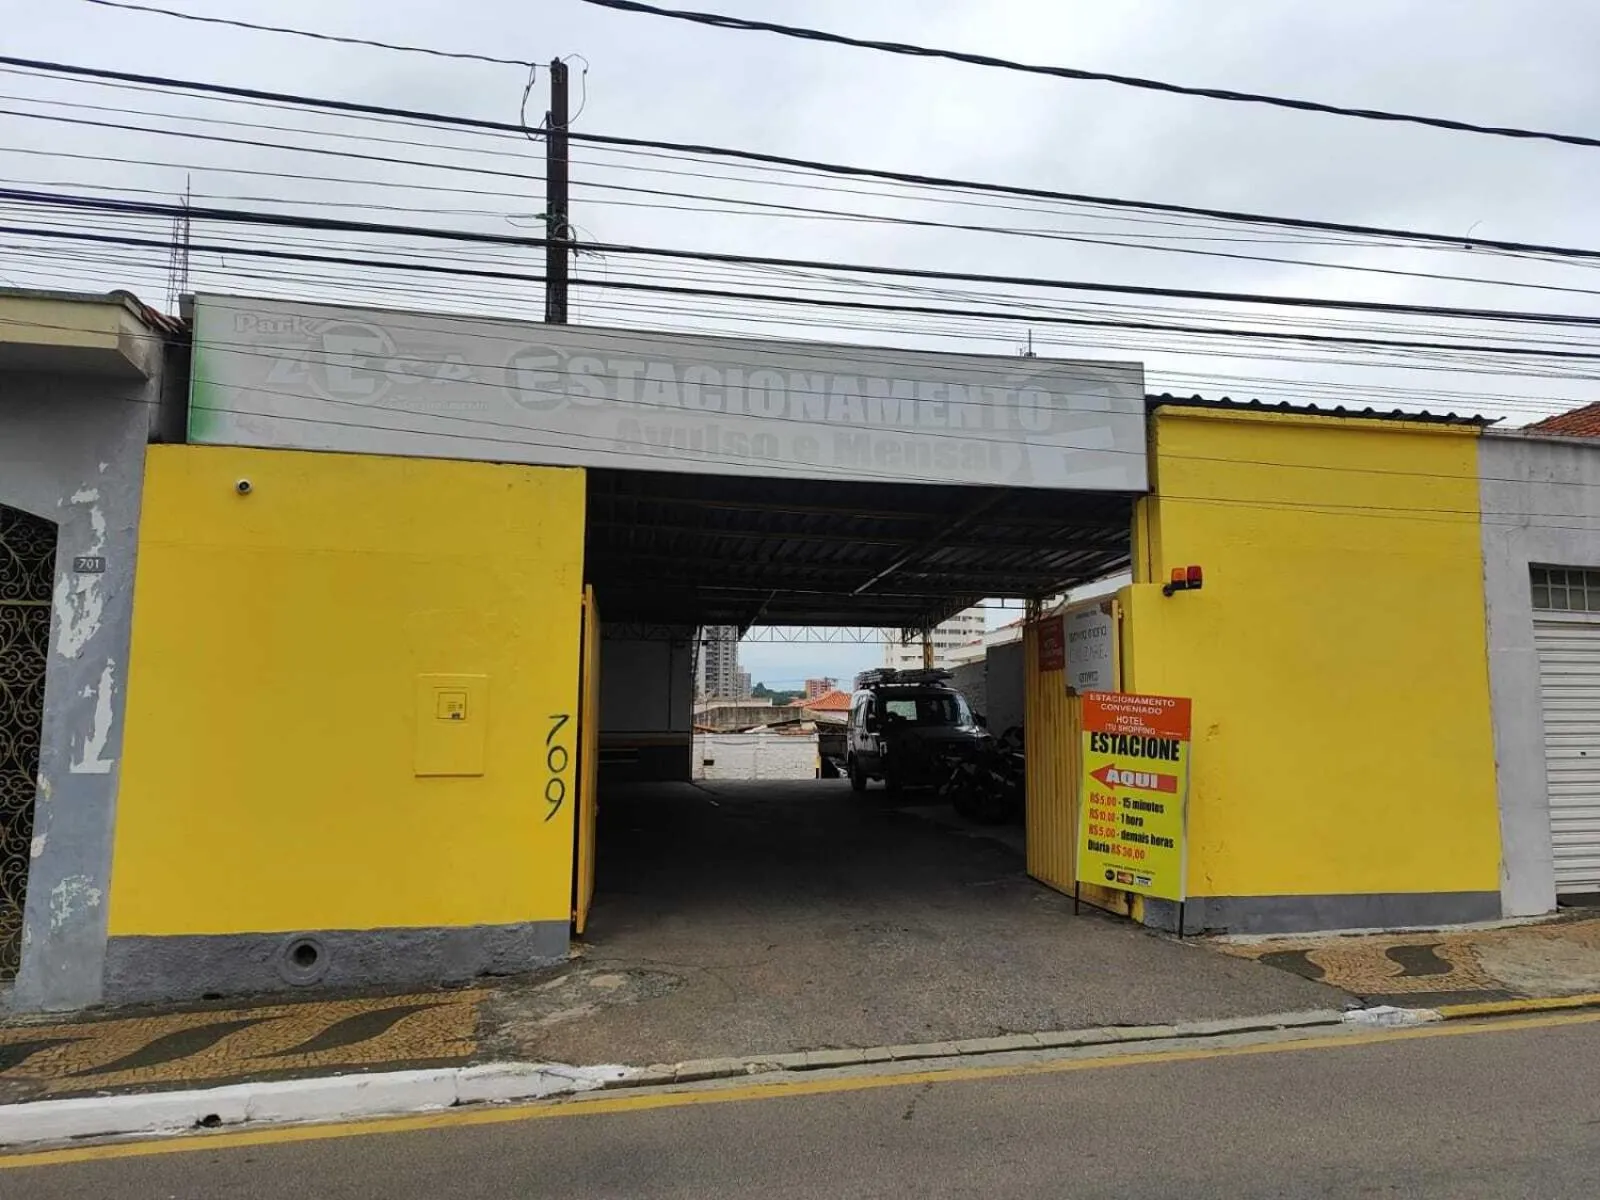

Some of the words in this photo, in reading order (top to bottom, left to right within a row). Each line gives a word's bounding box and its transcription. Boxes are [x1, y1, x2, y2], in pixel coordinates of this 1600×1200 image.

[512, 354, 1053, 431] ESTACIONAMENTO
[614, 417, 779, 459] Avulso
[78, 558, 99, 569] 701
[1091, 694, 1176, 707] ESTACIONAMENTO
[1100, 702, 1163, 715] CONVENIADO
[1116, 715, 1145, 725] HOTEL
[1118, 724, 1156, 735] SHOPPING
[1091, 732, 1180, 761] ESTACIONE
[544, 713, 570, 822] 709
[1106, 769, 1158, 788] AQUI
[1132, 799, 1164, 813] minutos
[1121, 829, 1149, 844] demais
[1150, 834, 1174, 847] horas
